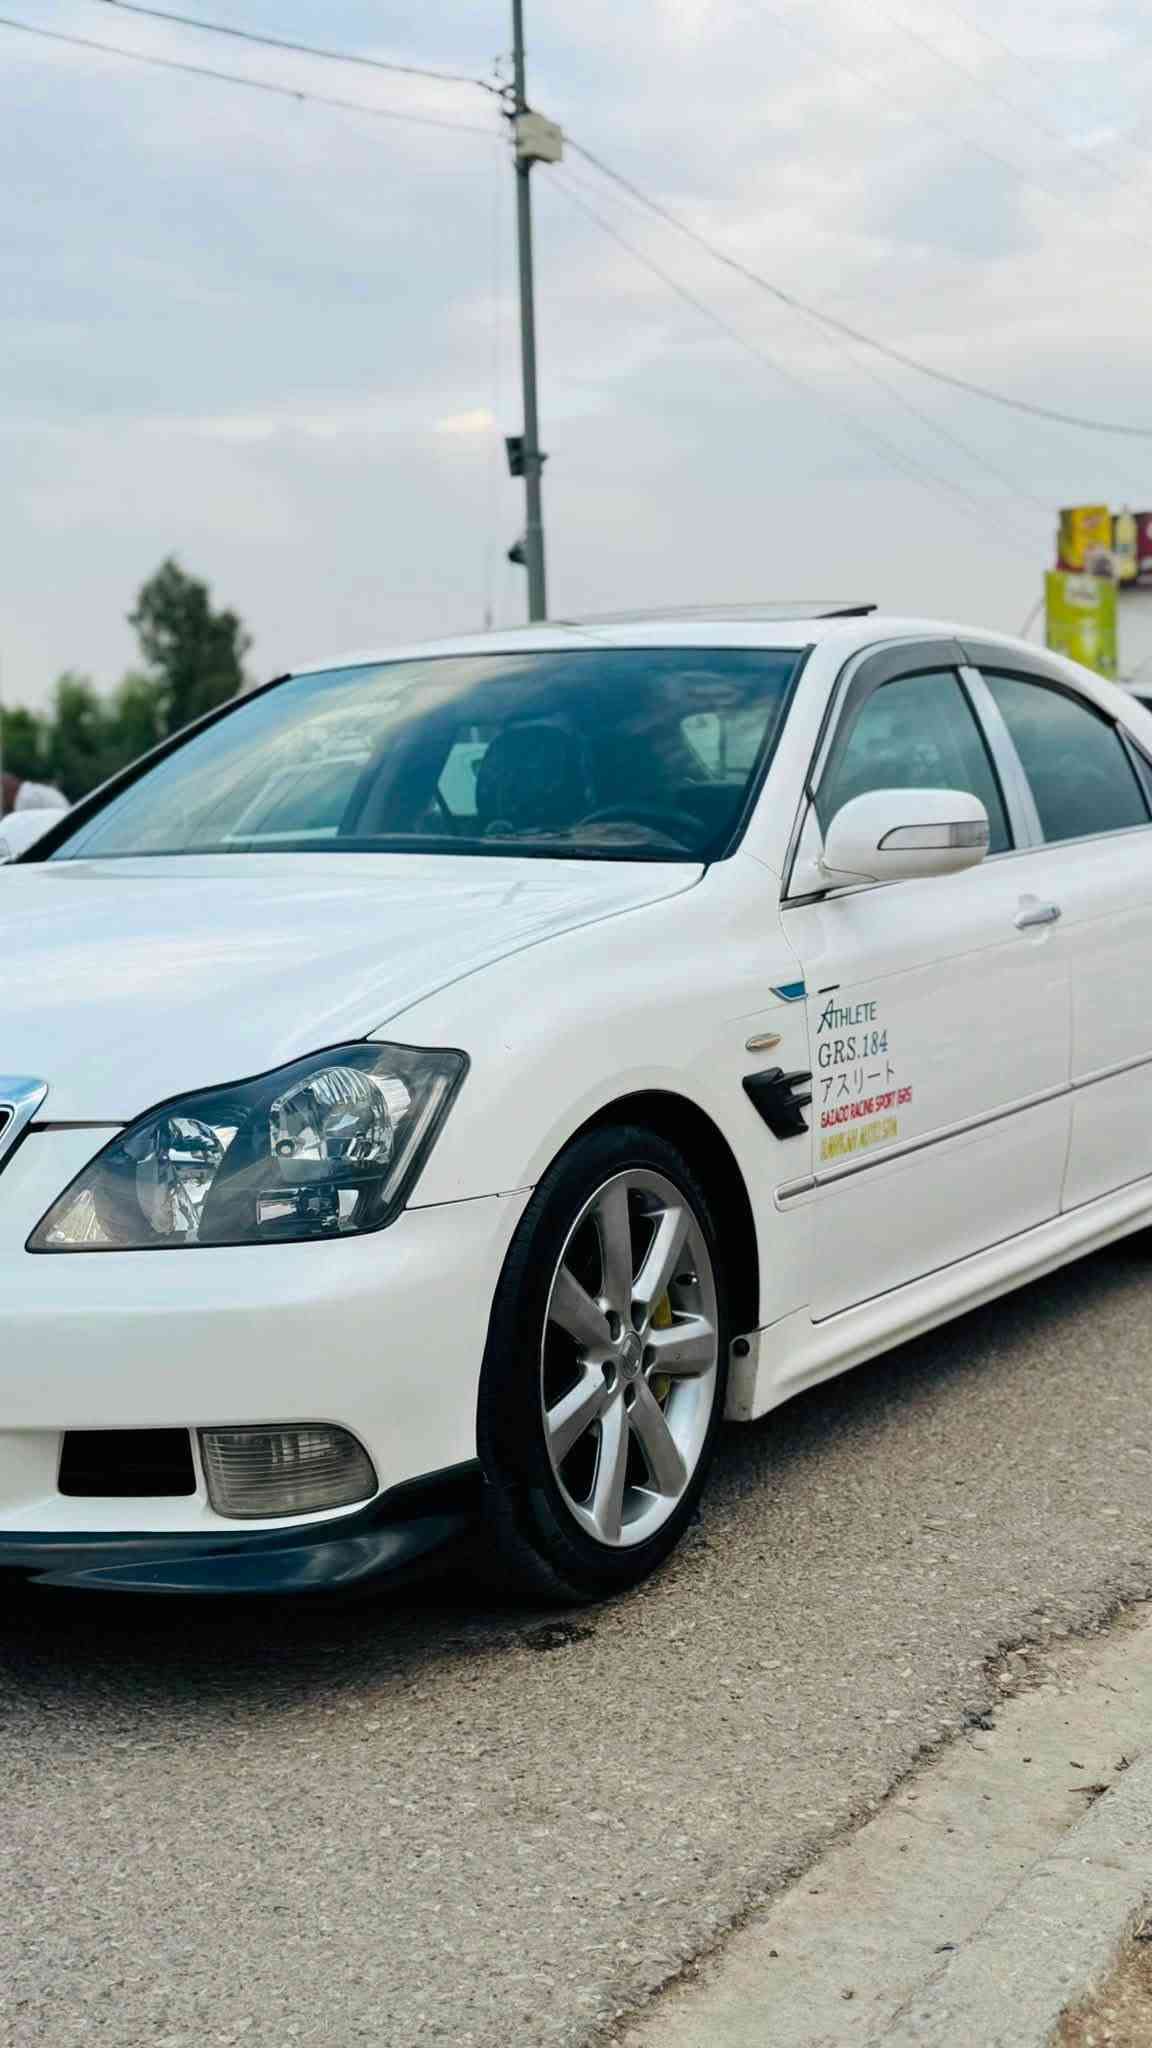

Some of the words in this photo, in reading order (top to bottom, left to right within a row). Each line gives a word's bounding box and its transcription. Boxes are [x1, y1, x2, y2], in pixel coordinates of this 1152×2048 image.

[820, 1060, 895, 1103] アスリート
